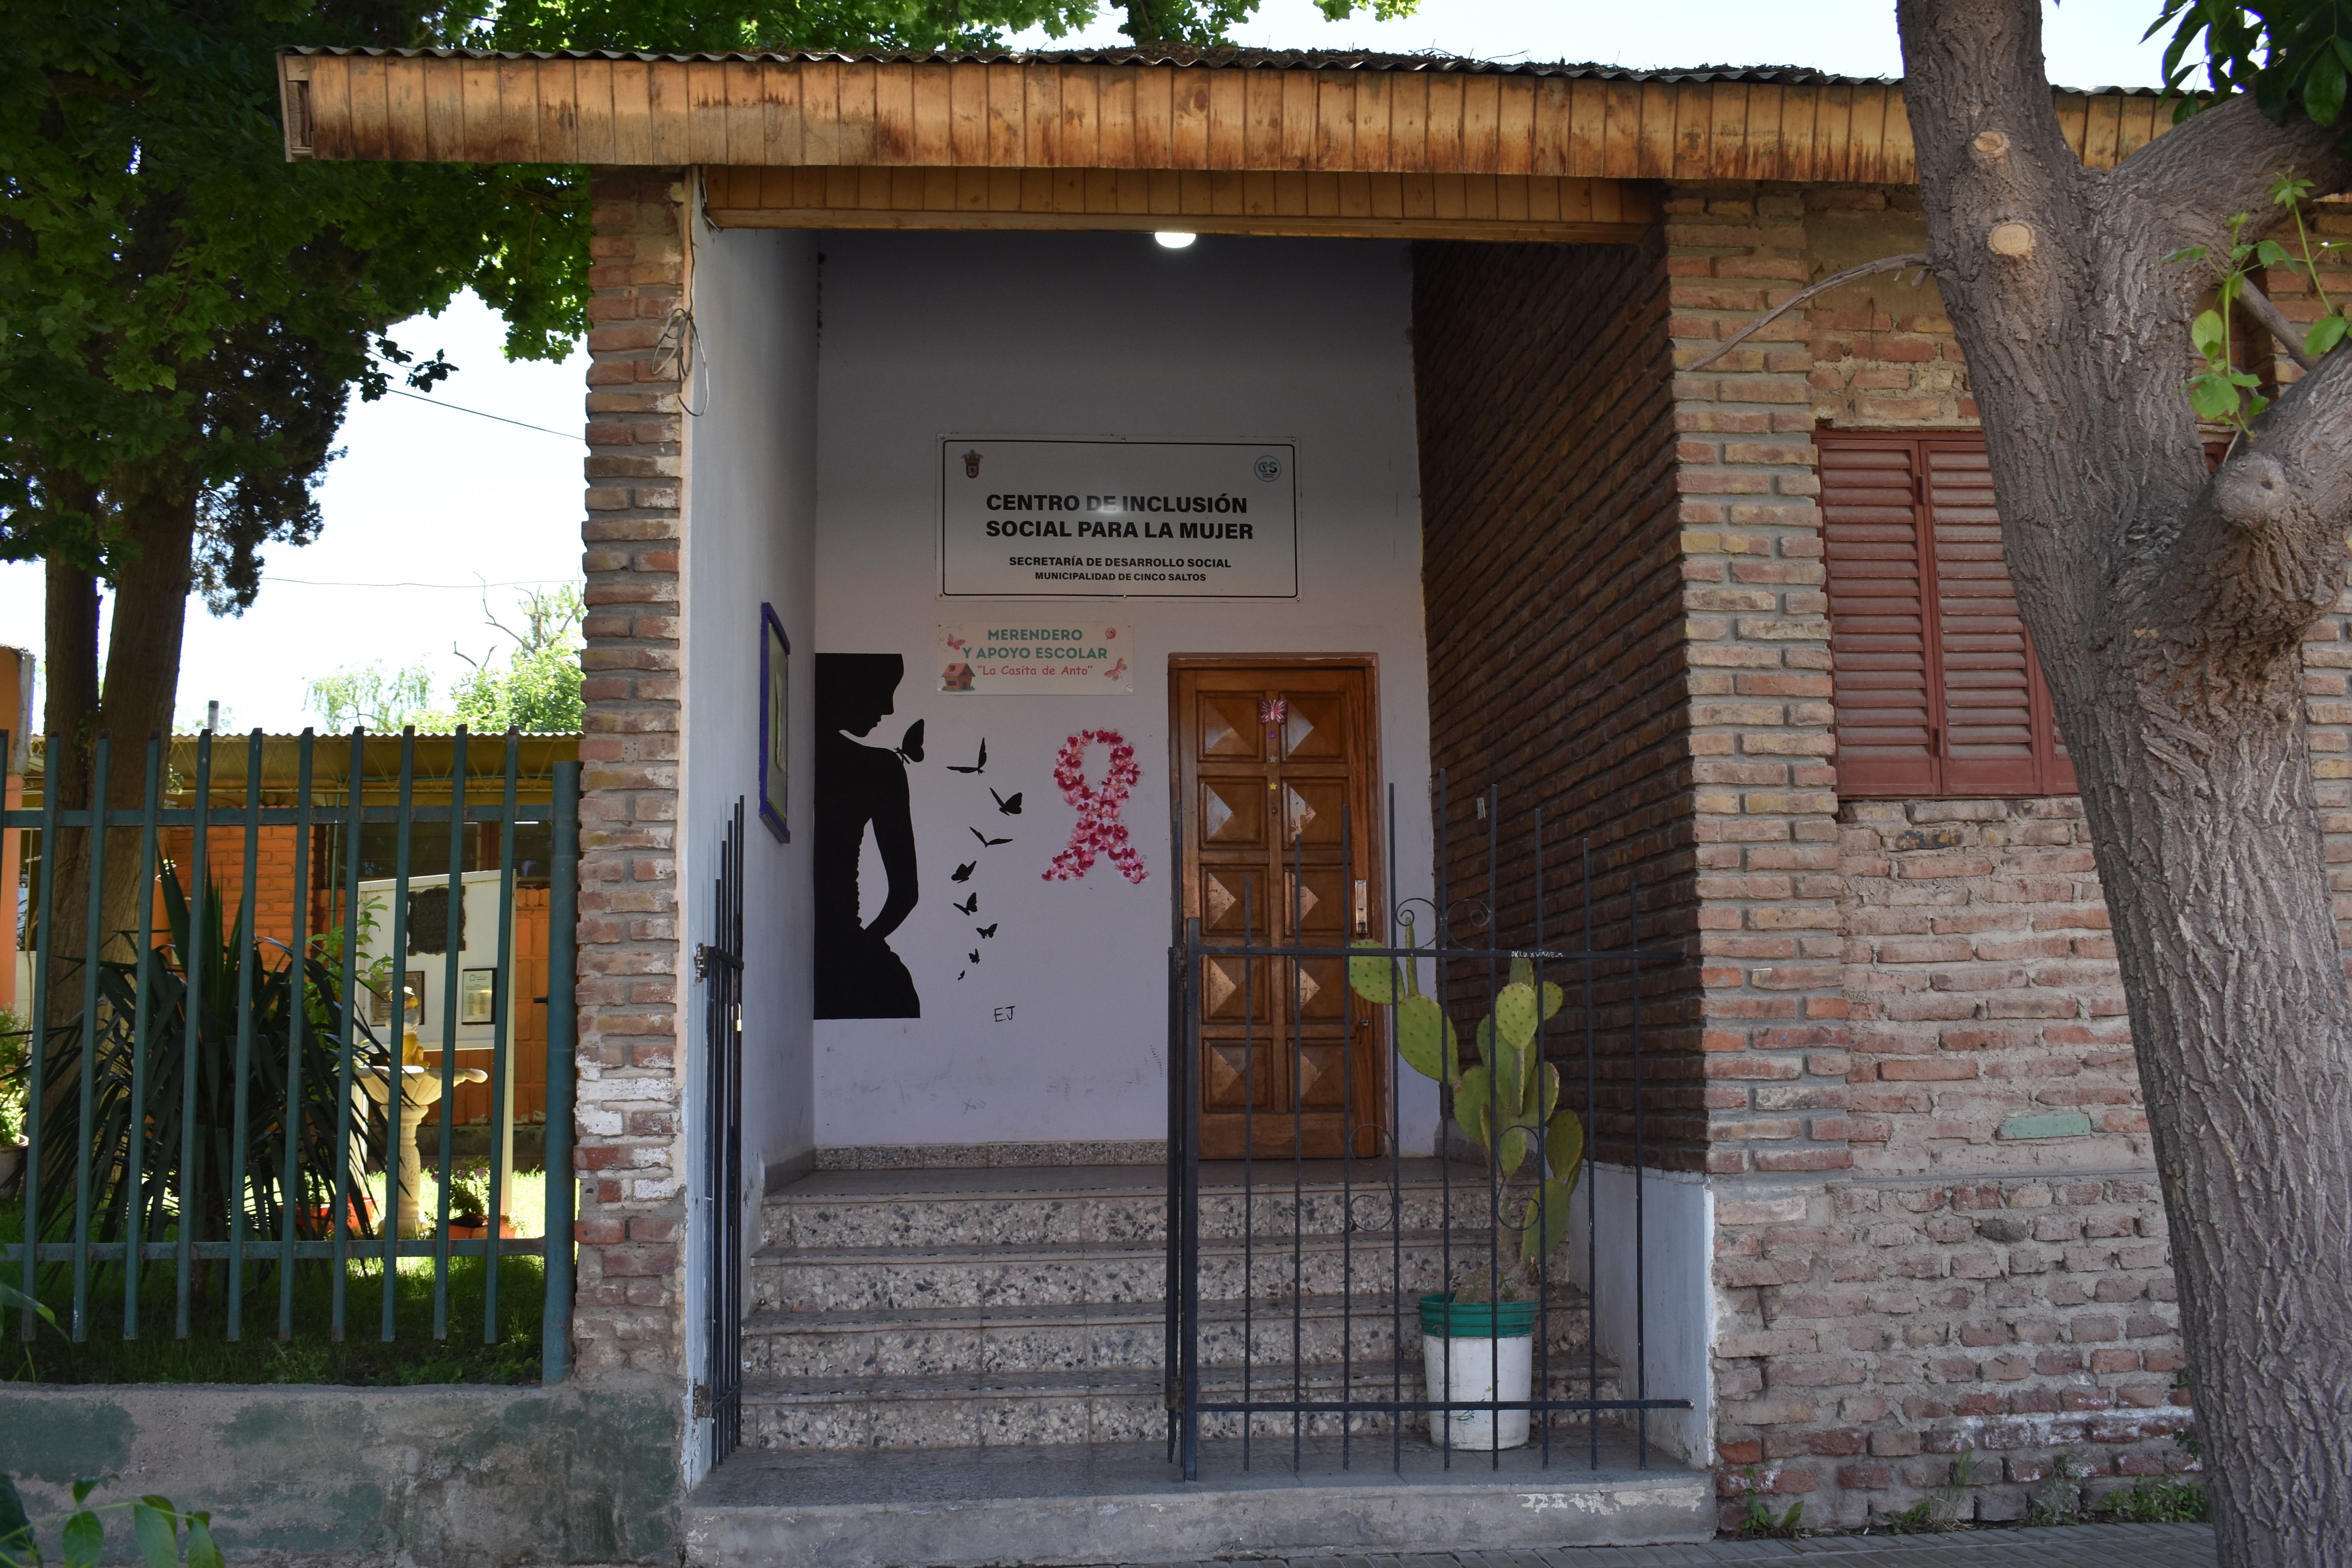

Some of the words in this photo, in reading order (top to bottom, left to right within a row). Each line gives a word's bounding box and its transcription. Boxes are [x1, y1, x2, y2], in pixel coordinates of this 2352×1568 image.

[986, 494, 1080, 511] CENTRO
[1087, 495, 1117, 512] DE
[1122, 493, 1247, 514] INCLUSIÓN
[986, 520, 1072, 538] SOCIAL
[1078, 521, 1139, 538] PARA
[1145, 522, 1174, 539] LA
[1180, 523, 1254, 540] MUJER
[1009, 555, 1084, 567] SECRETARÍA
[1087, 557, 1103, 567] DE
[1105, 558, 1185, 568] DESARROLLO
[1187, 558, 1232, 568] SOCIAL
[1035, 572, 1116, 581] MUNICIPALIDAD
[1118, 573, 1132, 582] DE
[1134, 573, 1166, 582] CINCO
[1168, 573, 1207, 582] SALTOS
[988, 629, 1083, 641] MERENDERO
[962, 647, 973, 659] Y
[976, 647, 1031, 659] APOYO
[1036, 647, 1108, 660] ESCOLAR
[1001, 665, 1038, 676] Casita
[1042, 665, 1056, 676] de
